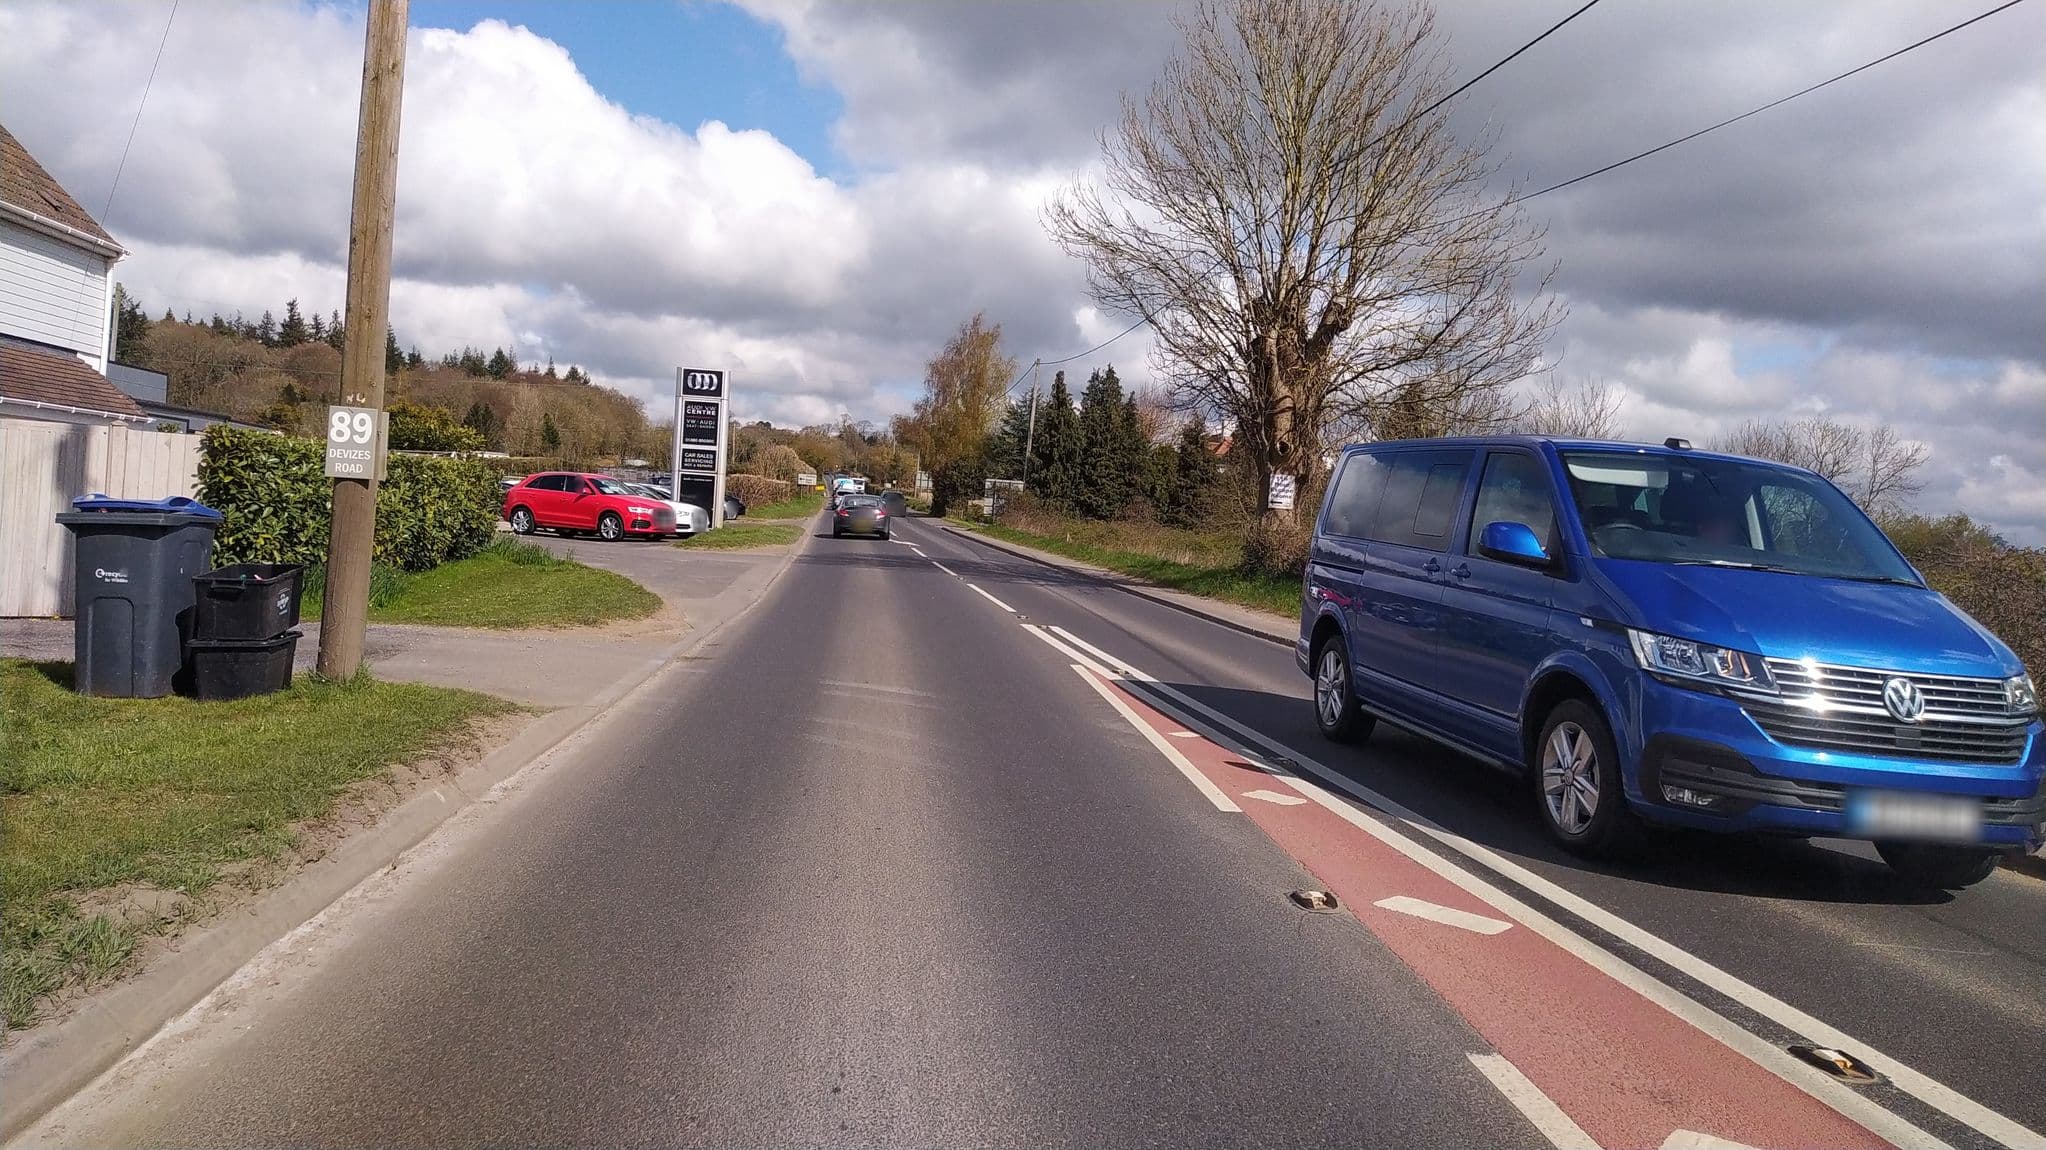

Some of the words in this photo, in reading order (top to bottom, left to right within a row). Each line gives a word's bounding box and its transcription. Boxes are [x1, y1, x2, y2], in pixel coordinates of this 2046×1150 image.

[686, 408, 717, 416] CENTRE
[330, 411, 372, 444] 89
[329, 448, 371, 460] DEVIZES
[335, 462, 363, 473] ROAD
